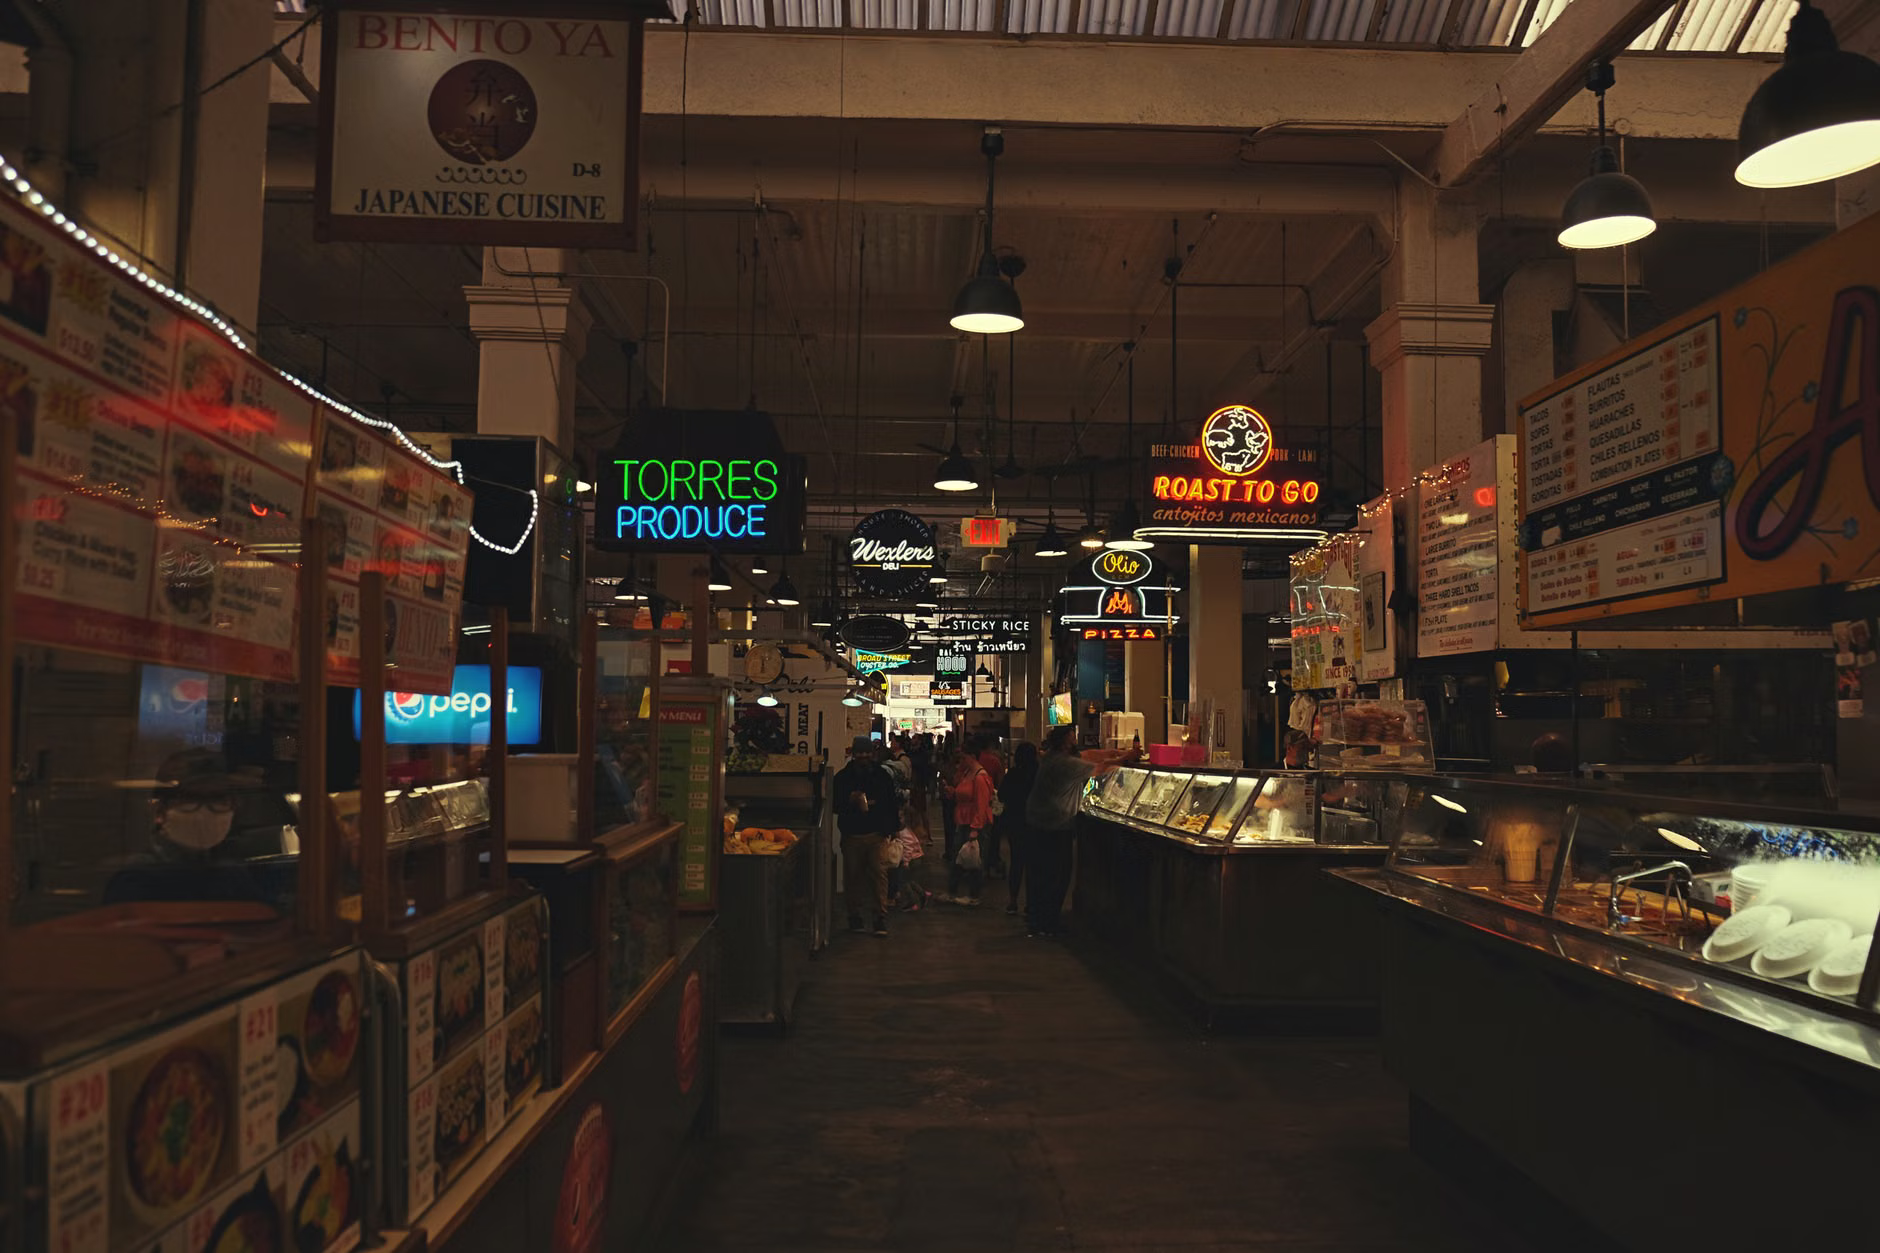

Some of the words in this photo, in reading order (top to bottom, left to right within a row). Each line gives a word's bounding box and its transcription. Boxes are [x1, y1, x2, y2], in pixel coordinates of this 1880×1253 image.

[355, 15, 533, 55] BENTO
[545, 21, 615, 58] YA
[573, 163, 601, 177] D-8
[355, 189, 490, 216] JAPANESE
[496, 193, 606, 220] CUISINE
[1587, 373, 1621, 398] FLAUTAS
[1588, 389, 1626, 415] BURRITOS
[1530, 408, 1549, 425] TACOS
[1589, 402, 1635, 432] HUARACHES
[1530, 424, 1550, 441] SOPES
[1589, 418, 1642, 449] QUESADILLAS
[1530, 439, 1554, 457] TORTAS
[1590, 440, 1616, 466] CHILES
[1618, 430, 1660, 455] RELLENOS
[1590, 456, 1633, 483] COMBINATION
[1634, 448, 1661, 468] PLATES
[613, 459, 779, 501] TORRES
[1531, 467, 1562, 489] TOSTADAS
[1154, 476, 1237, 501] ROAST
[1243, 480, 1276, 502] TO
[1280, 480, 1320, 504] GO
[1531, 484, 1562, 504] GORDITAS
[616, 503, 768, 540] PRODUCE
[1153, 505, 1224, 526] antojitos
[1229, 508, 1318, 525] mexicanos
[970, 519, 1001, 545] EXIT
[850, 537, 935, 561] Wexler's
[882, 562, 900, 571] DELI
[1103, 553, 1140, 574] Olio
[1451, 585, 1464, 597] SHELL
[1465, 582, 1479, 593] TACOS
[952, 620, 996, 631] STICKY
[1002, 620, 1030, 631] RICE
[1083, 628, 1156, 639] PIZZA
[1325, 668, 1341, 680] SINCE
[669, 711, 702, 721] MENU
[798, 703, 808, 736] MEAT
